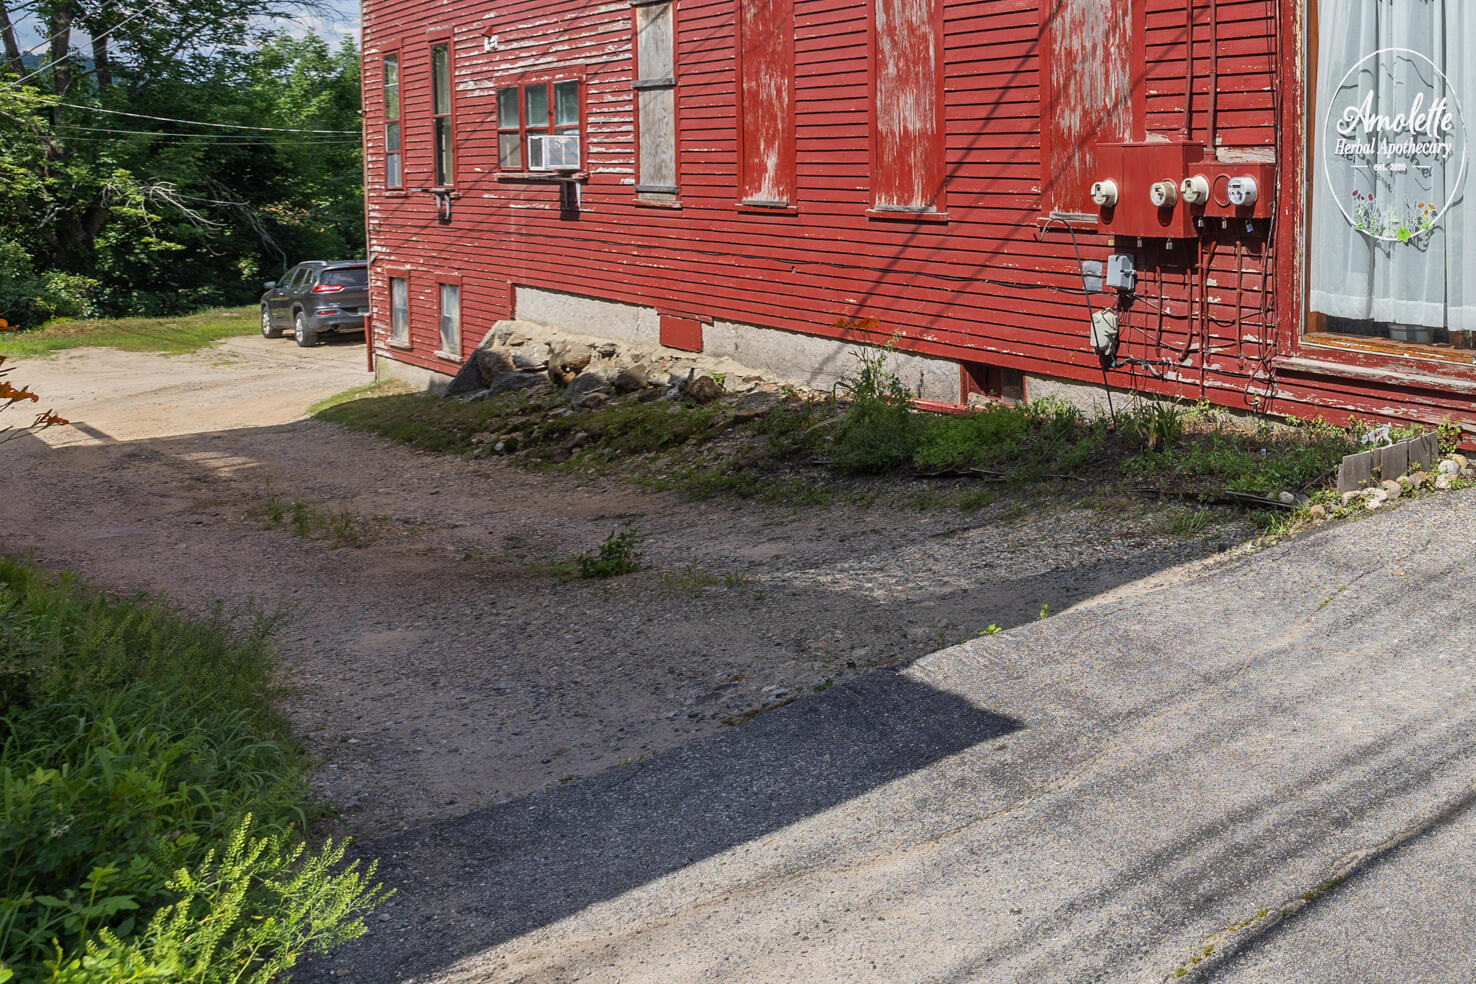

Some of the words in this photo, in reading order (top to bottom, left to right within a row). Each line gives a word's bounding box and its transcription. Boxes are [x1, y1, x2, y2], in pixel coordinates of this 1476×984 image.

[1336, 89, 1453, 139] Amolette
[1334, 137, 1375, 155] Herbal
[1377, 137, 1452, 159] Apothecary
